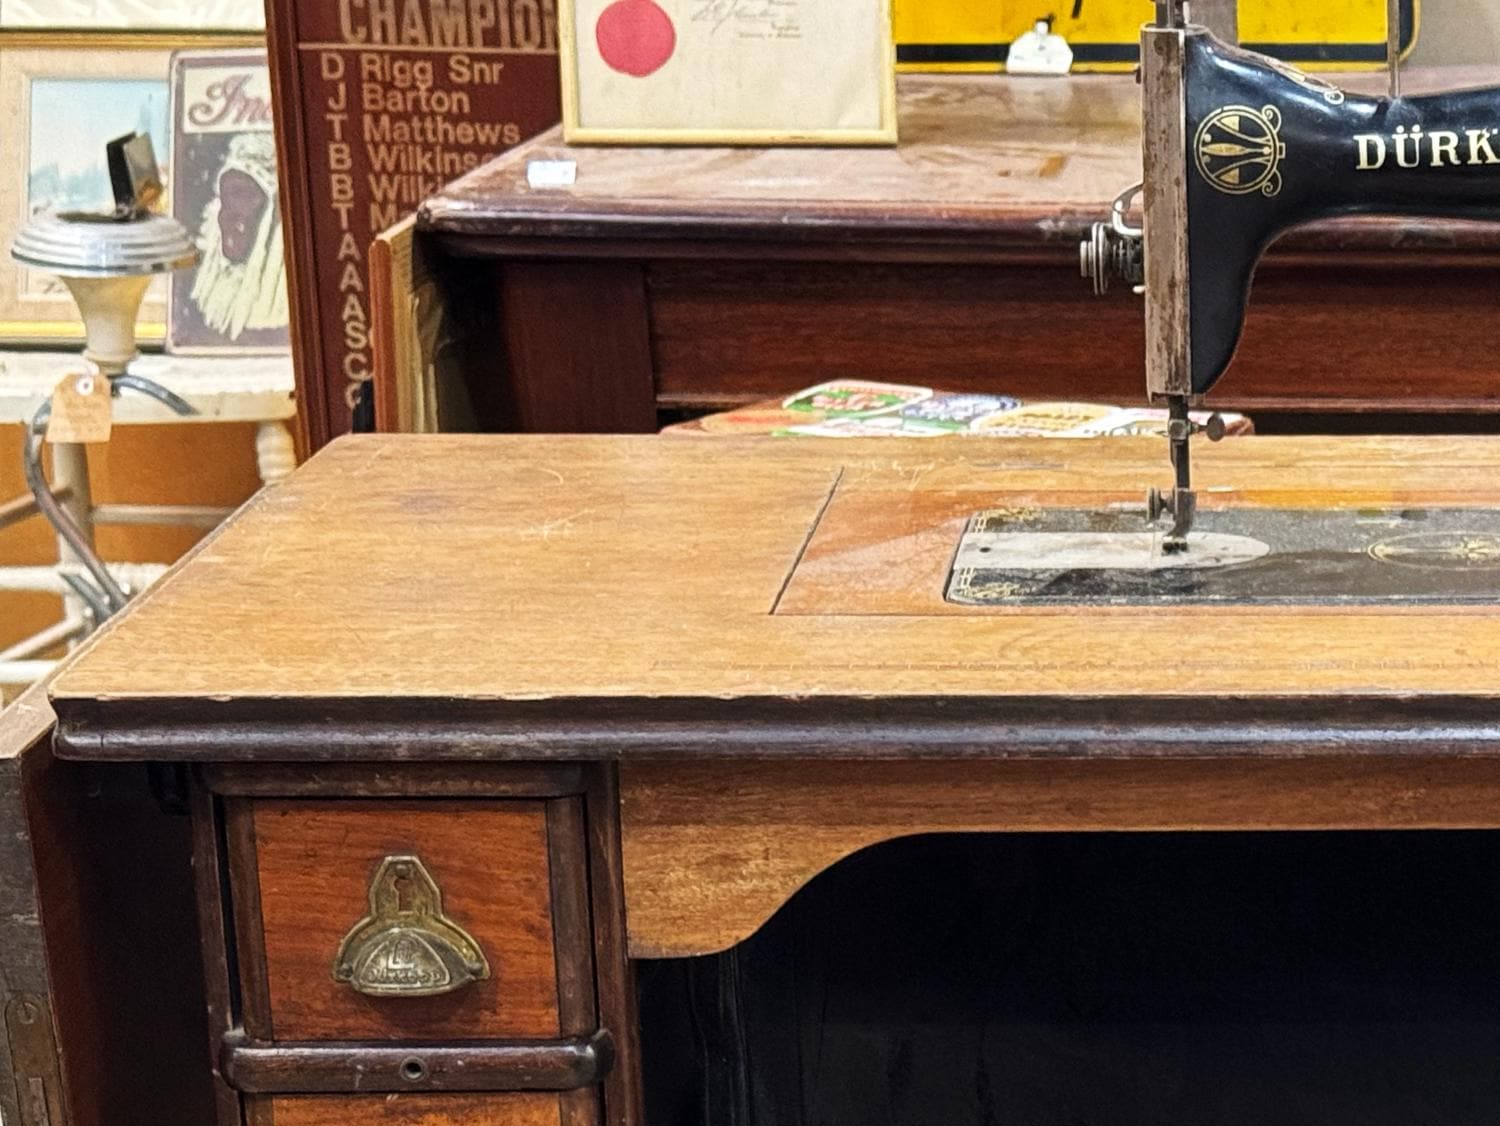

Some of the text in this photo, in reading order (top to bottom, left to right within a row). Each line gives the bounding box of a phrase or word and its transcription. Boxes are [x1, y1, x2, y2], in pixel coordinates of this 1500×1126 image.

[321, 53, 504, 88] D Rigg Snr
[328, 82, 471, 114] J Barton
[326, 113, 521, 145] T Matthews
[329, 143, 352, 170] B
[331, 173, 354, 200] B
[331, 203, 354, 230] T
[337, 232, 361, 262] A
[340, 262, 364, 292] A
[342, 293, 366, 321] A
[345, 321, 368, 349] S
